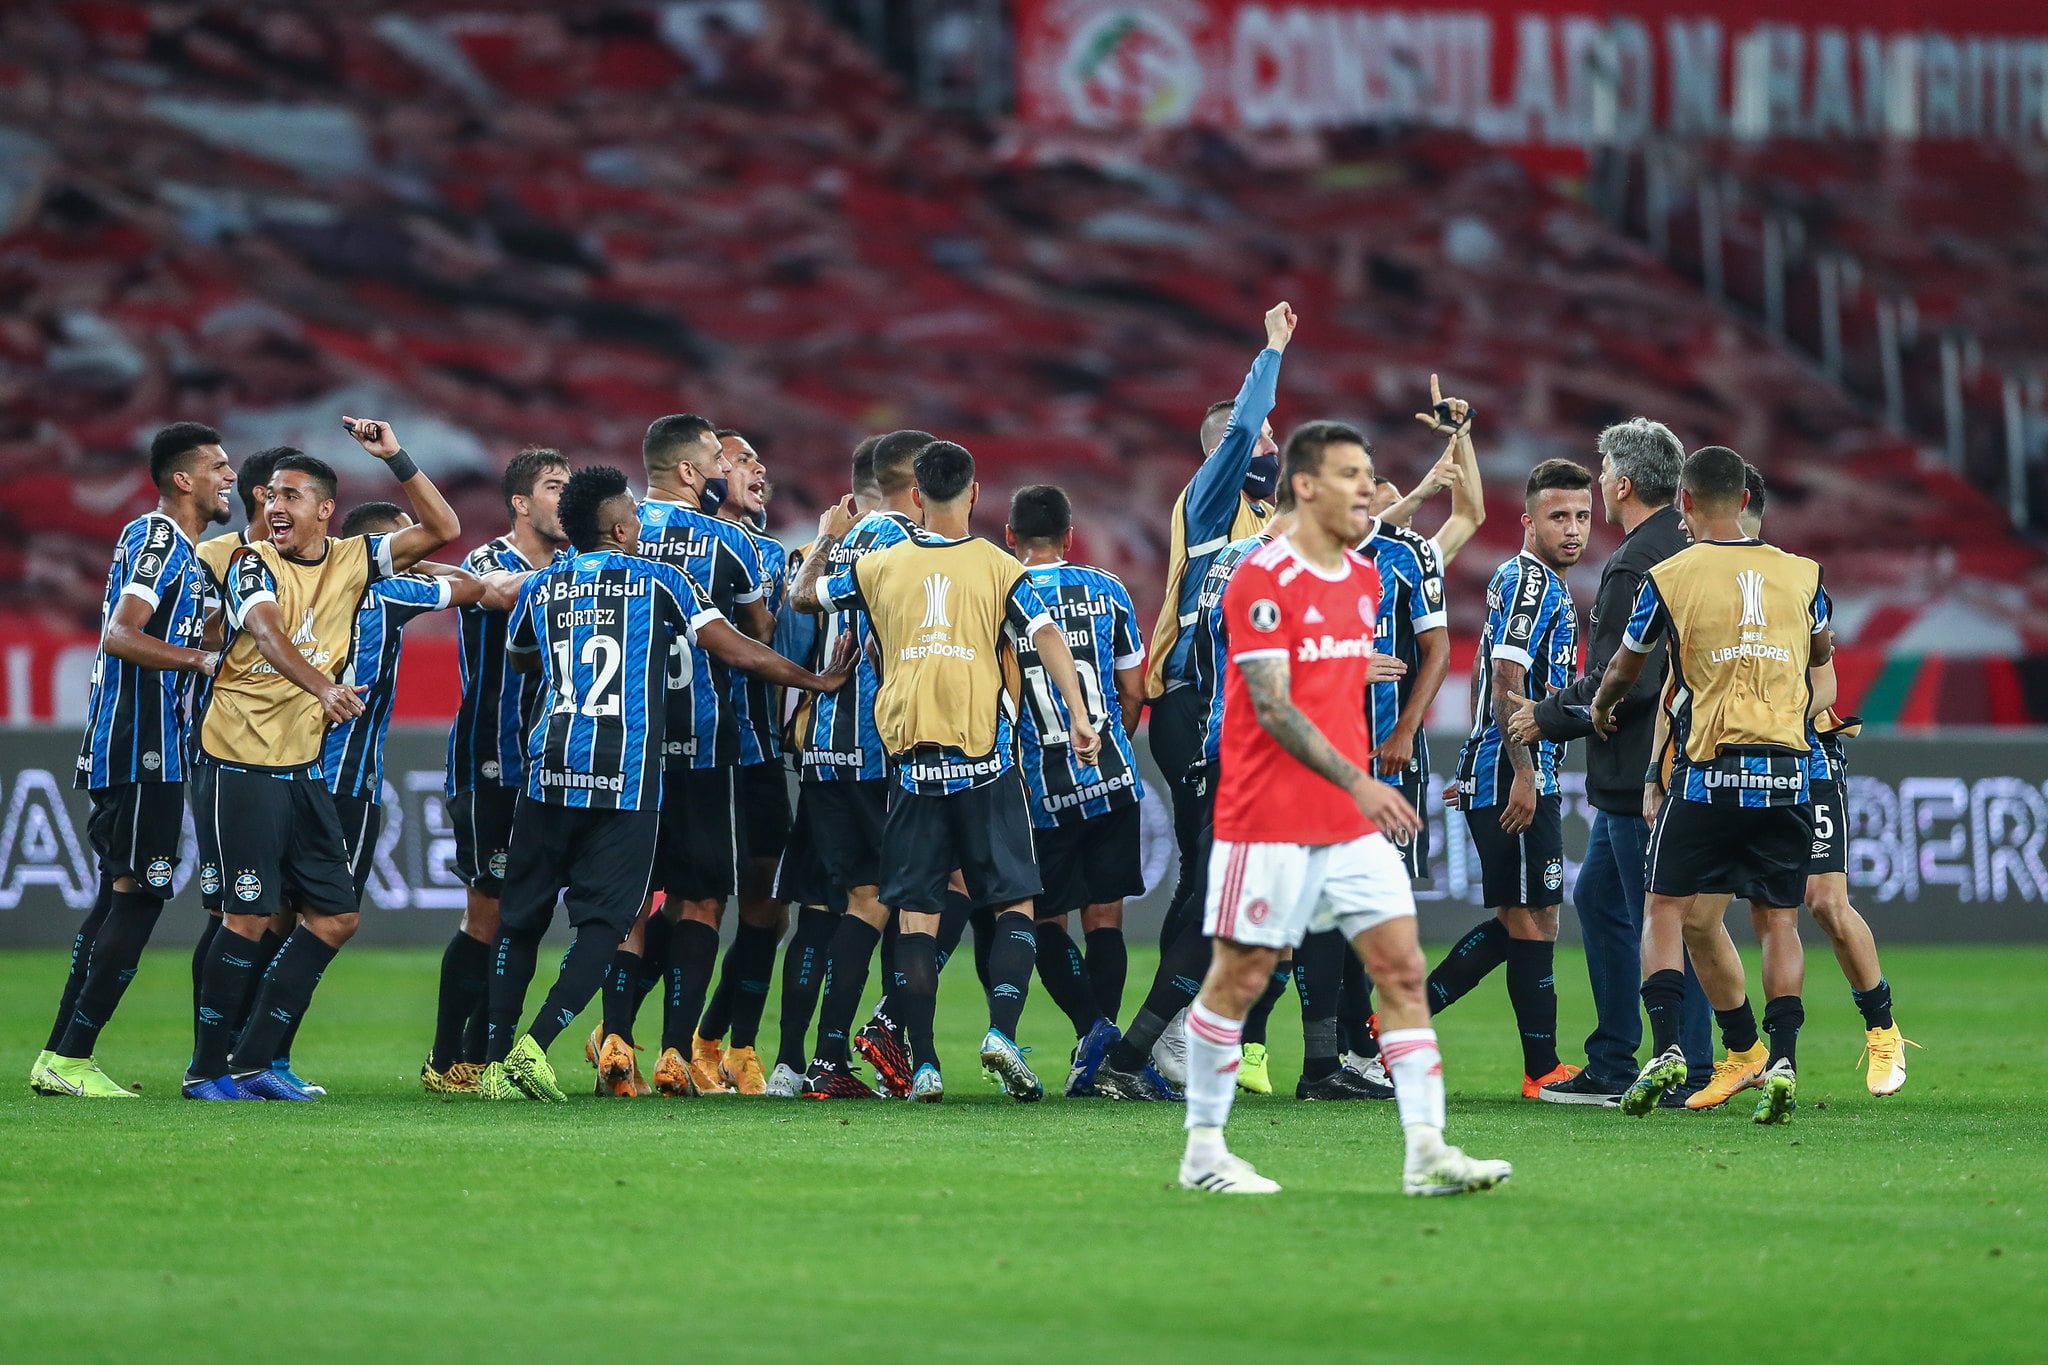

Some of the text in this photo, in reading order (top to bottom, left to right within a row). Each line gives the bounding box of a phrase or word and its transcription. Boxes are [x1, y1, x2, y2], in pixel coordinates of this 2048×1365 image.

[636, 536, 708, 557] anrisul
[1394, 526, 1431, 557] vero
[553, 577, 646, 601] Banrisul
[557, 609, 615, 629] CORTEZ
[1047, 594, 1107, 620] nrisul
[552, 634, 621, 716] 12
[802, 746, 863, 766] nimed
[911, 753, 1002, 781] Unimed
[539, 768, 625, 792] Unimed
[1042, 766, 1135, 813] Unimed
[1704, 768, 1803, 790] Unimed
[1814, 804, 1834, 839] 5
[1811, 852, 1830, 860] mbro
